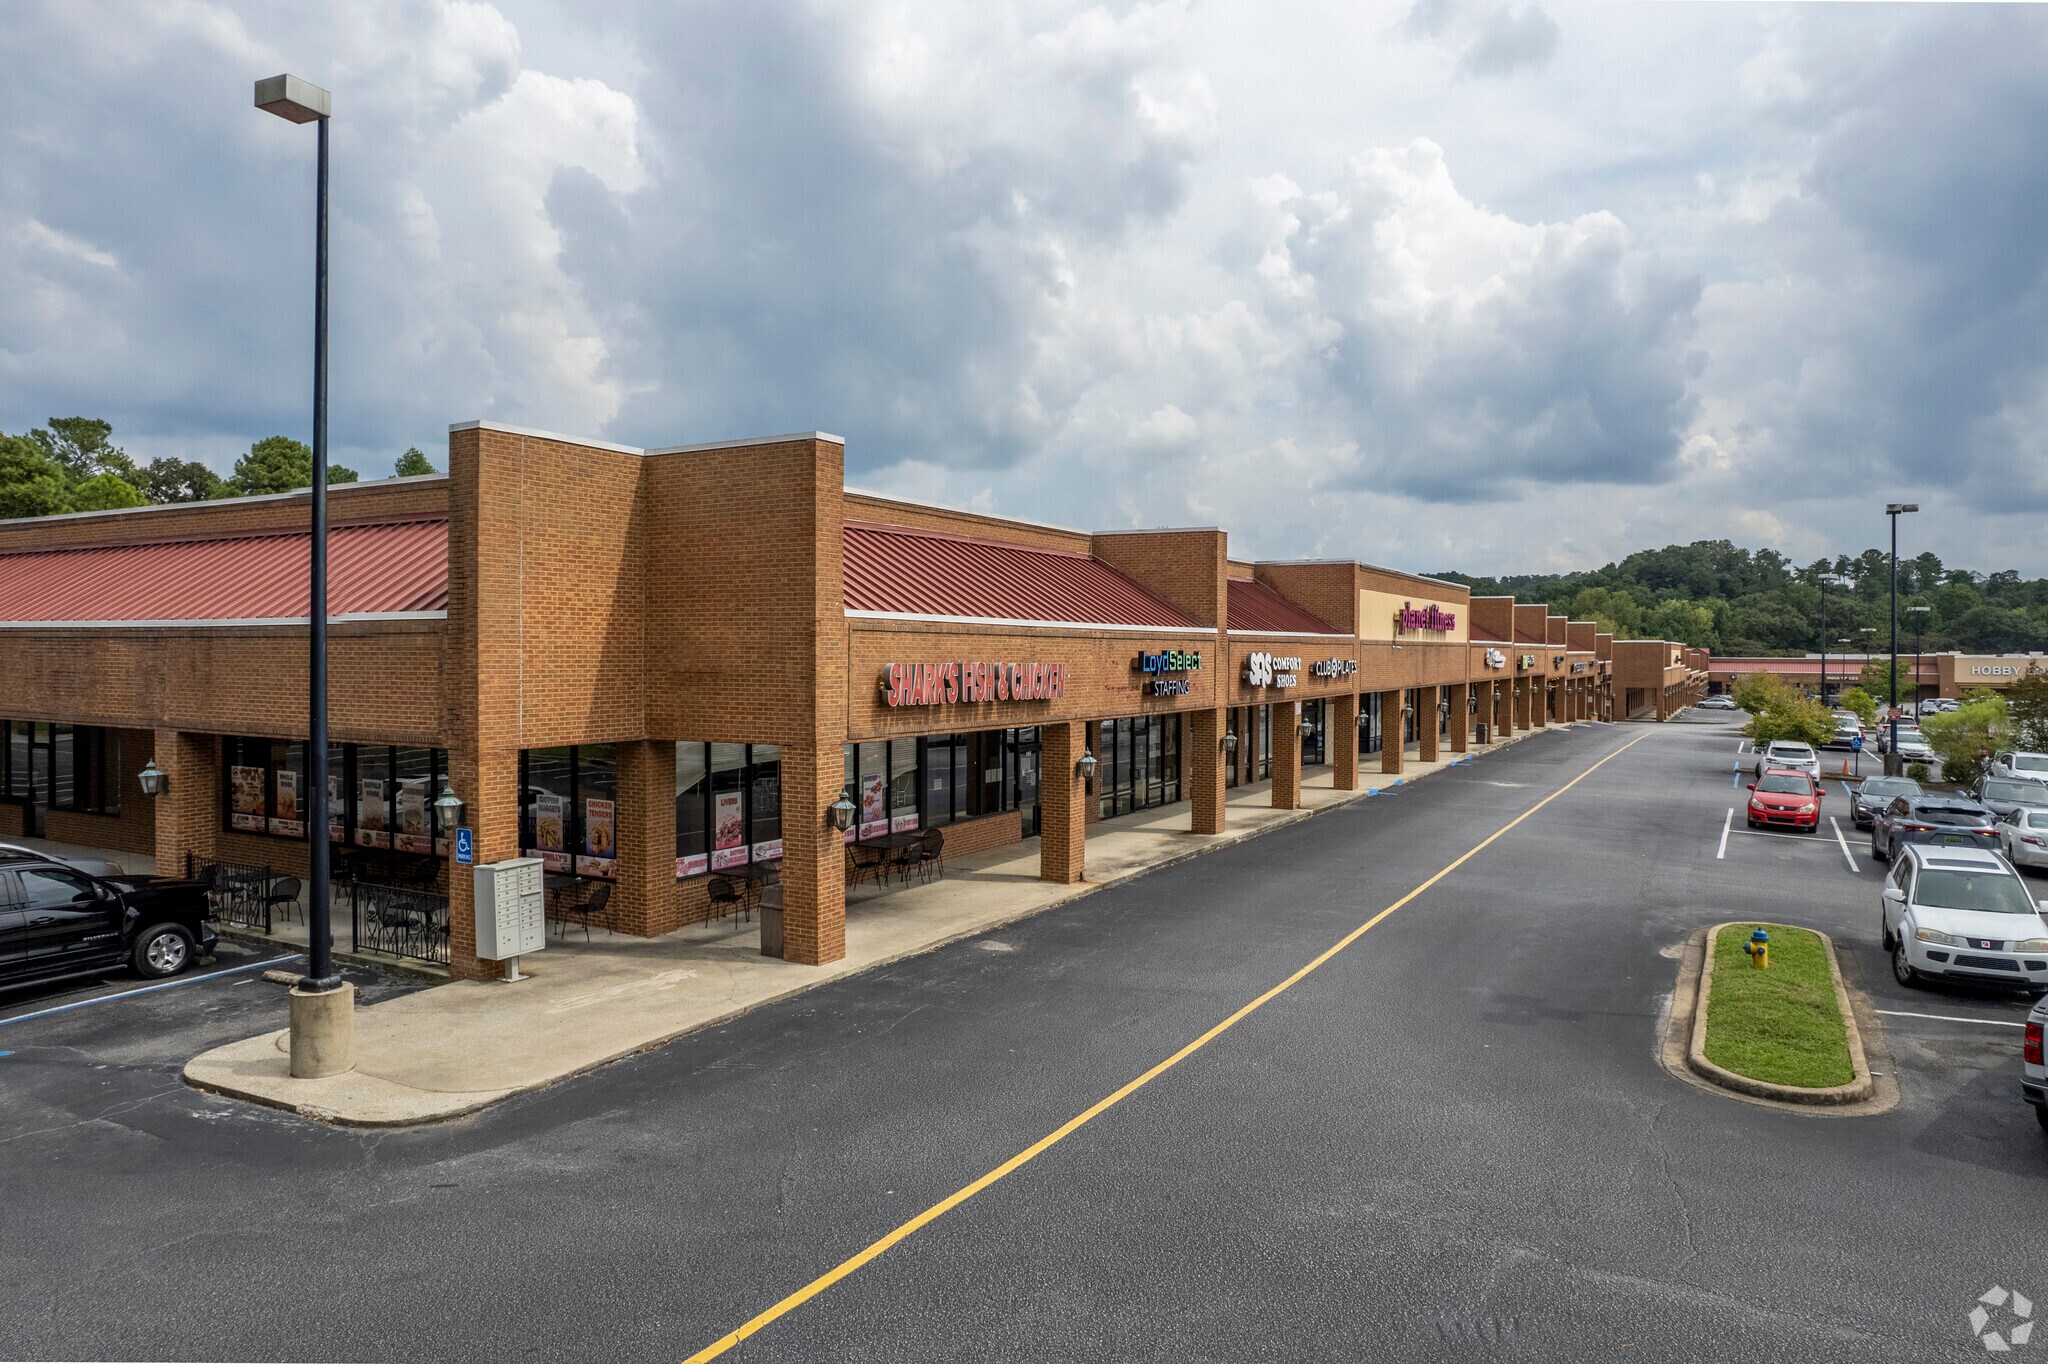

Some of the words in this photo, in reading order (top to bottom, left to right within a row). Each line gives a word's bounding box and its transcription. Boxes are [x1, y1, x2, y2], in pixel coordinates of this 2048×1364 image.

[1401, 601, 1428, 636] planet
[1430, 603, 1456, 631] fitness
[1143, 650, 1202, 676] LoydSelect
[1249, 652, 1273, 688] SAS
[1272, 657, 1302, 671] COMFORT
[1316, 661, 1331, 676] CLUB
[1337, 660, 1358, 675] PILATES
[1971, 666, 2021, 675] HOBBY
[886, 662, 959, 707] SHARK'S
[962, 662, 994, 703] FISH
[998, 662, 1009, 700] &
[1011, 662, 1066, 700] CHICKEN
[1154, 680, 1190, 696] STAFFING
[1276, 674, 1297, 688] SHOES
[538, 804, 560, 813] NUGGETS
[588, 800, 612, 809] CHICKEN
[720, 797, 738, 806] LIVERS
[589, 810, 612, 818] TENDERS
[542, 852, 568, 862] PHILLY'S
